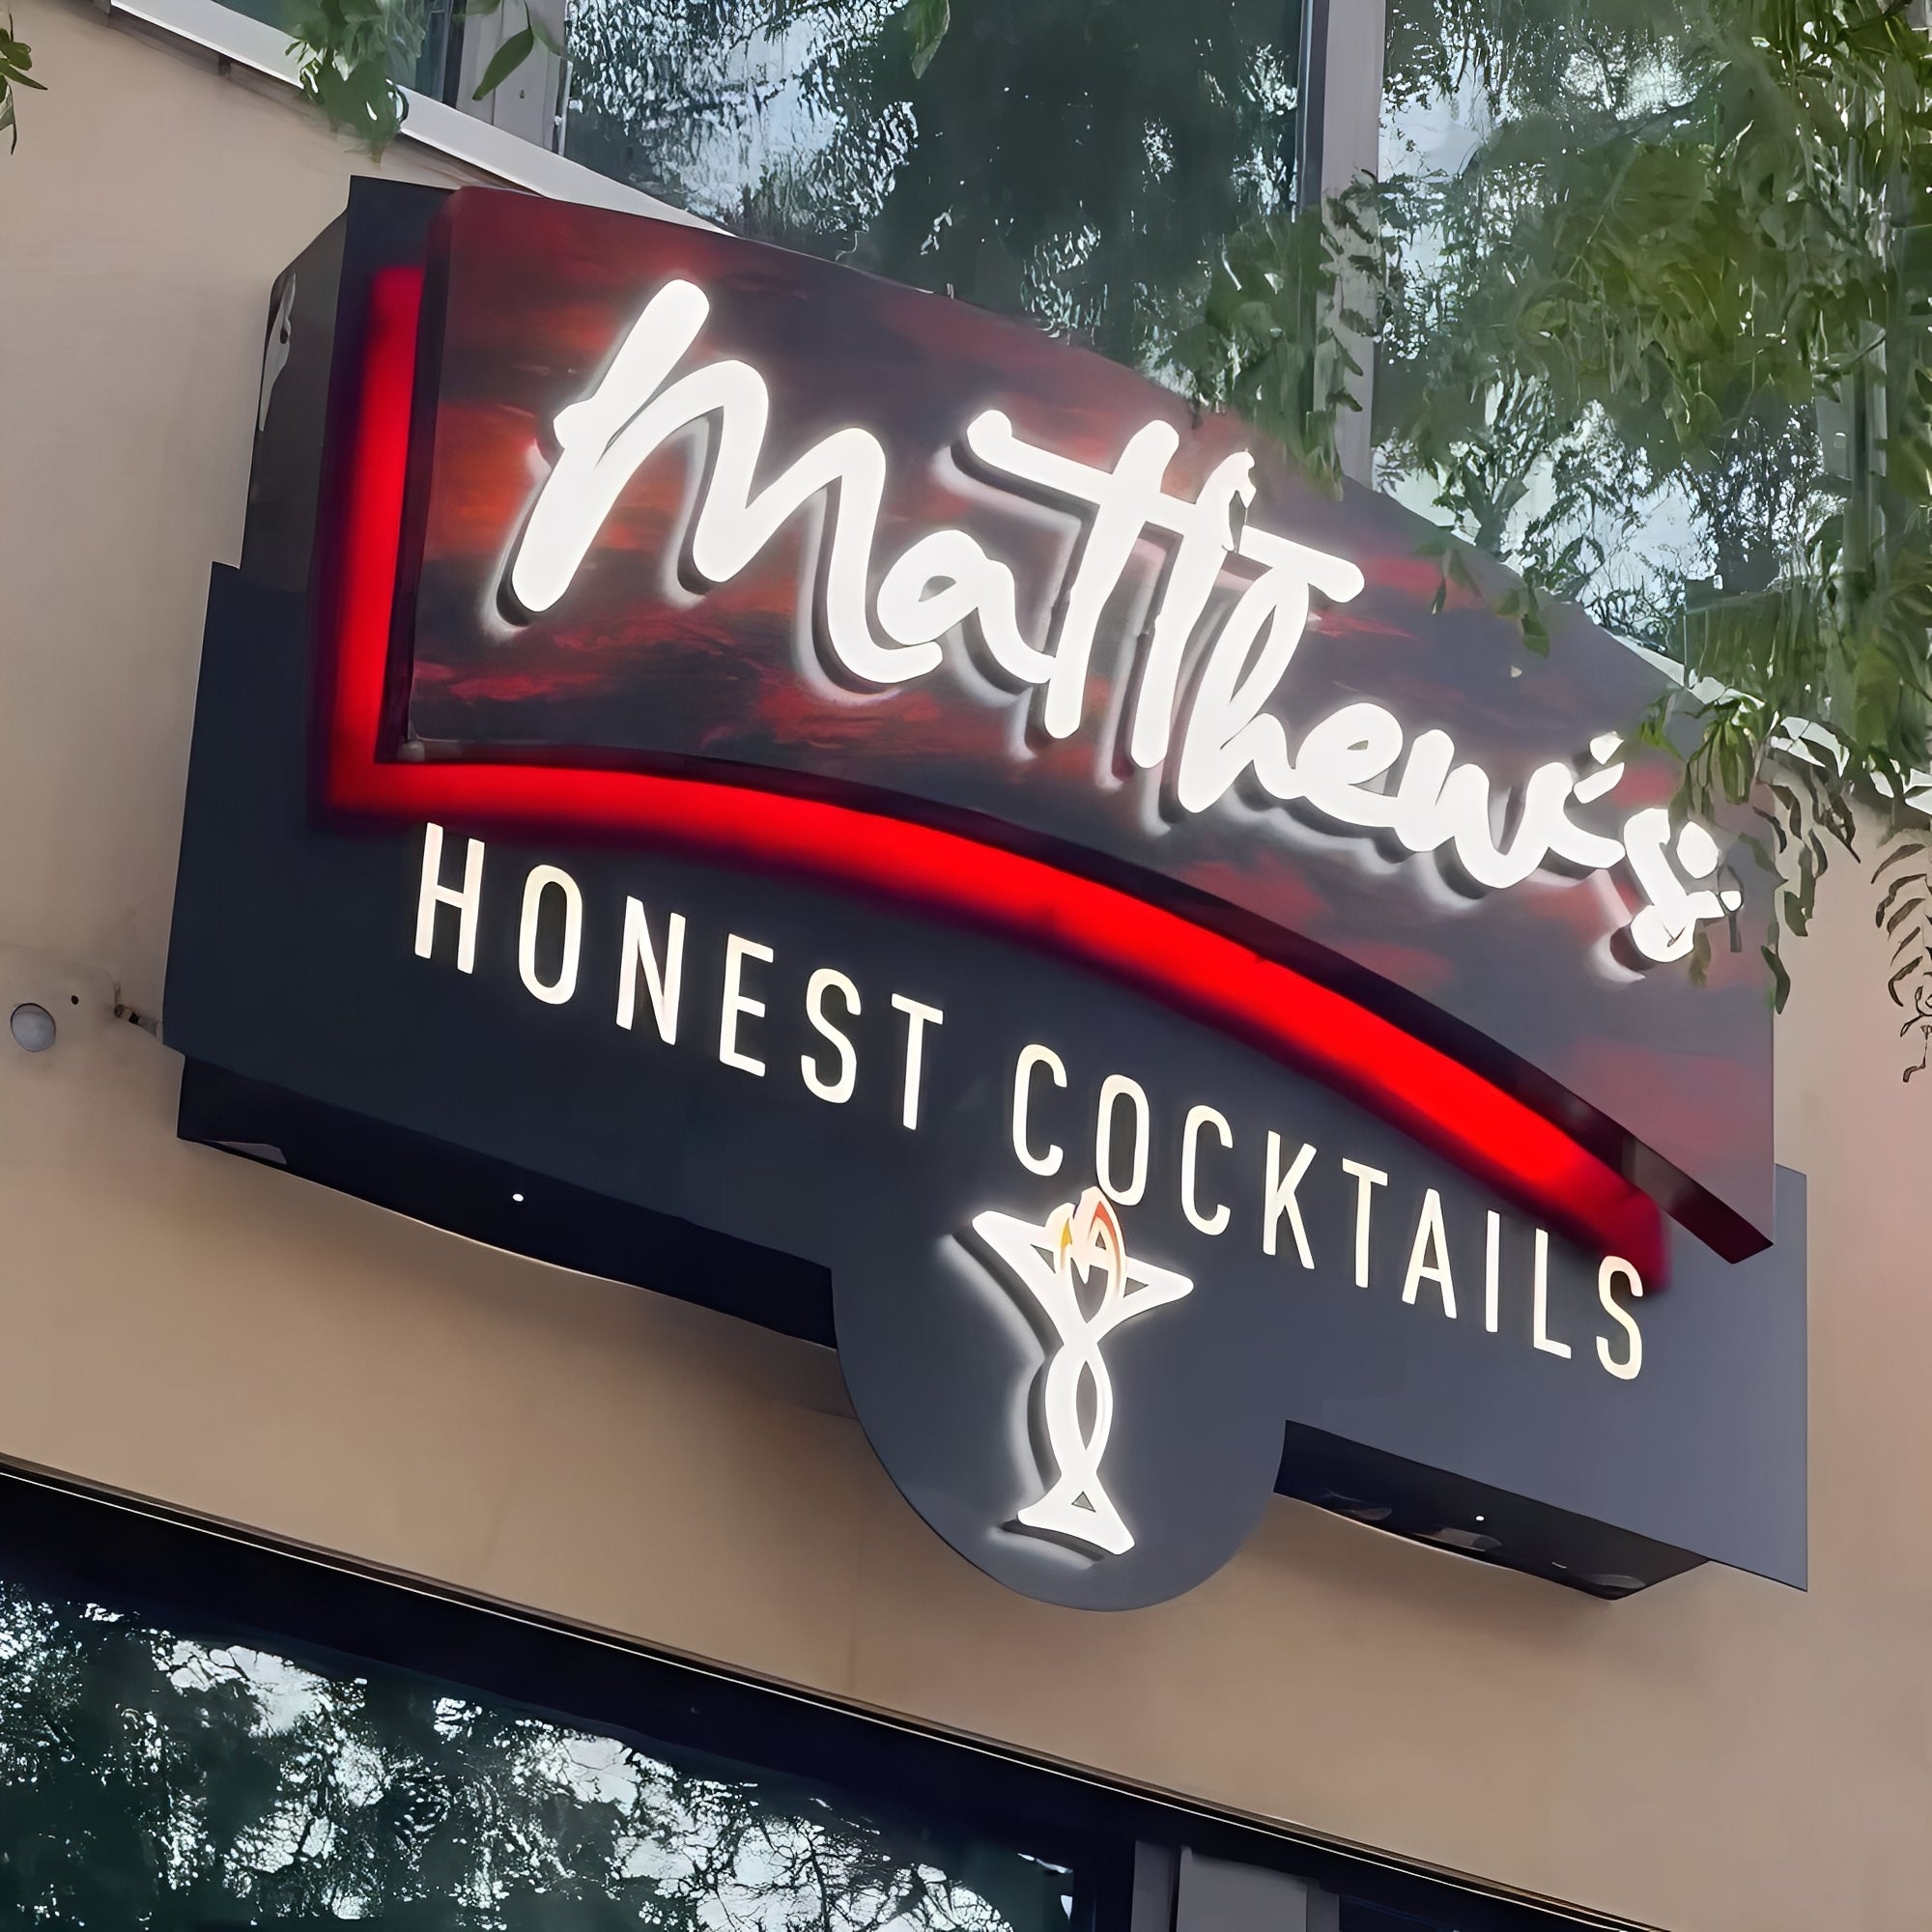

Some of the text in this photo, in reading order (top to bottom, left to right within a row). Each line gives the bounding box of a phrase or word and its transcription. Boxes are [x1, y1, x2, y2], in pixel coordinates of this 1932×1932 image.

[512, 279, 1742, 963] Matthew's
[413, 822, 1644, 1380] HONEST COCKTAILS
